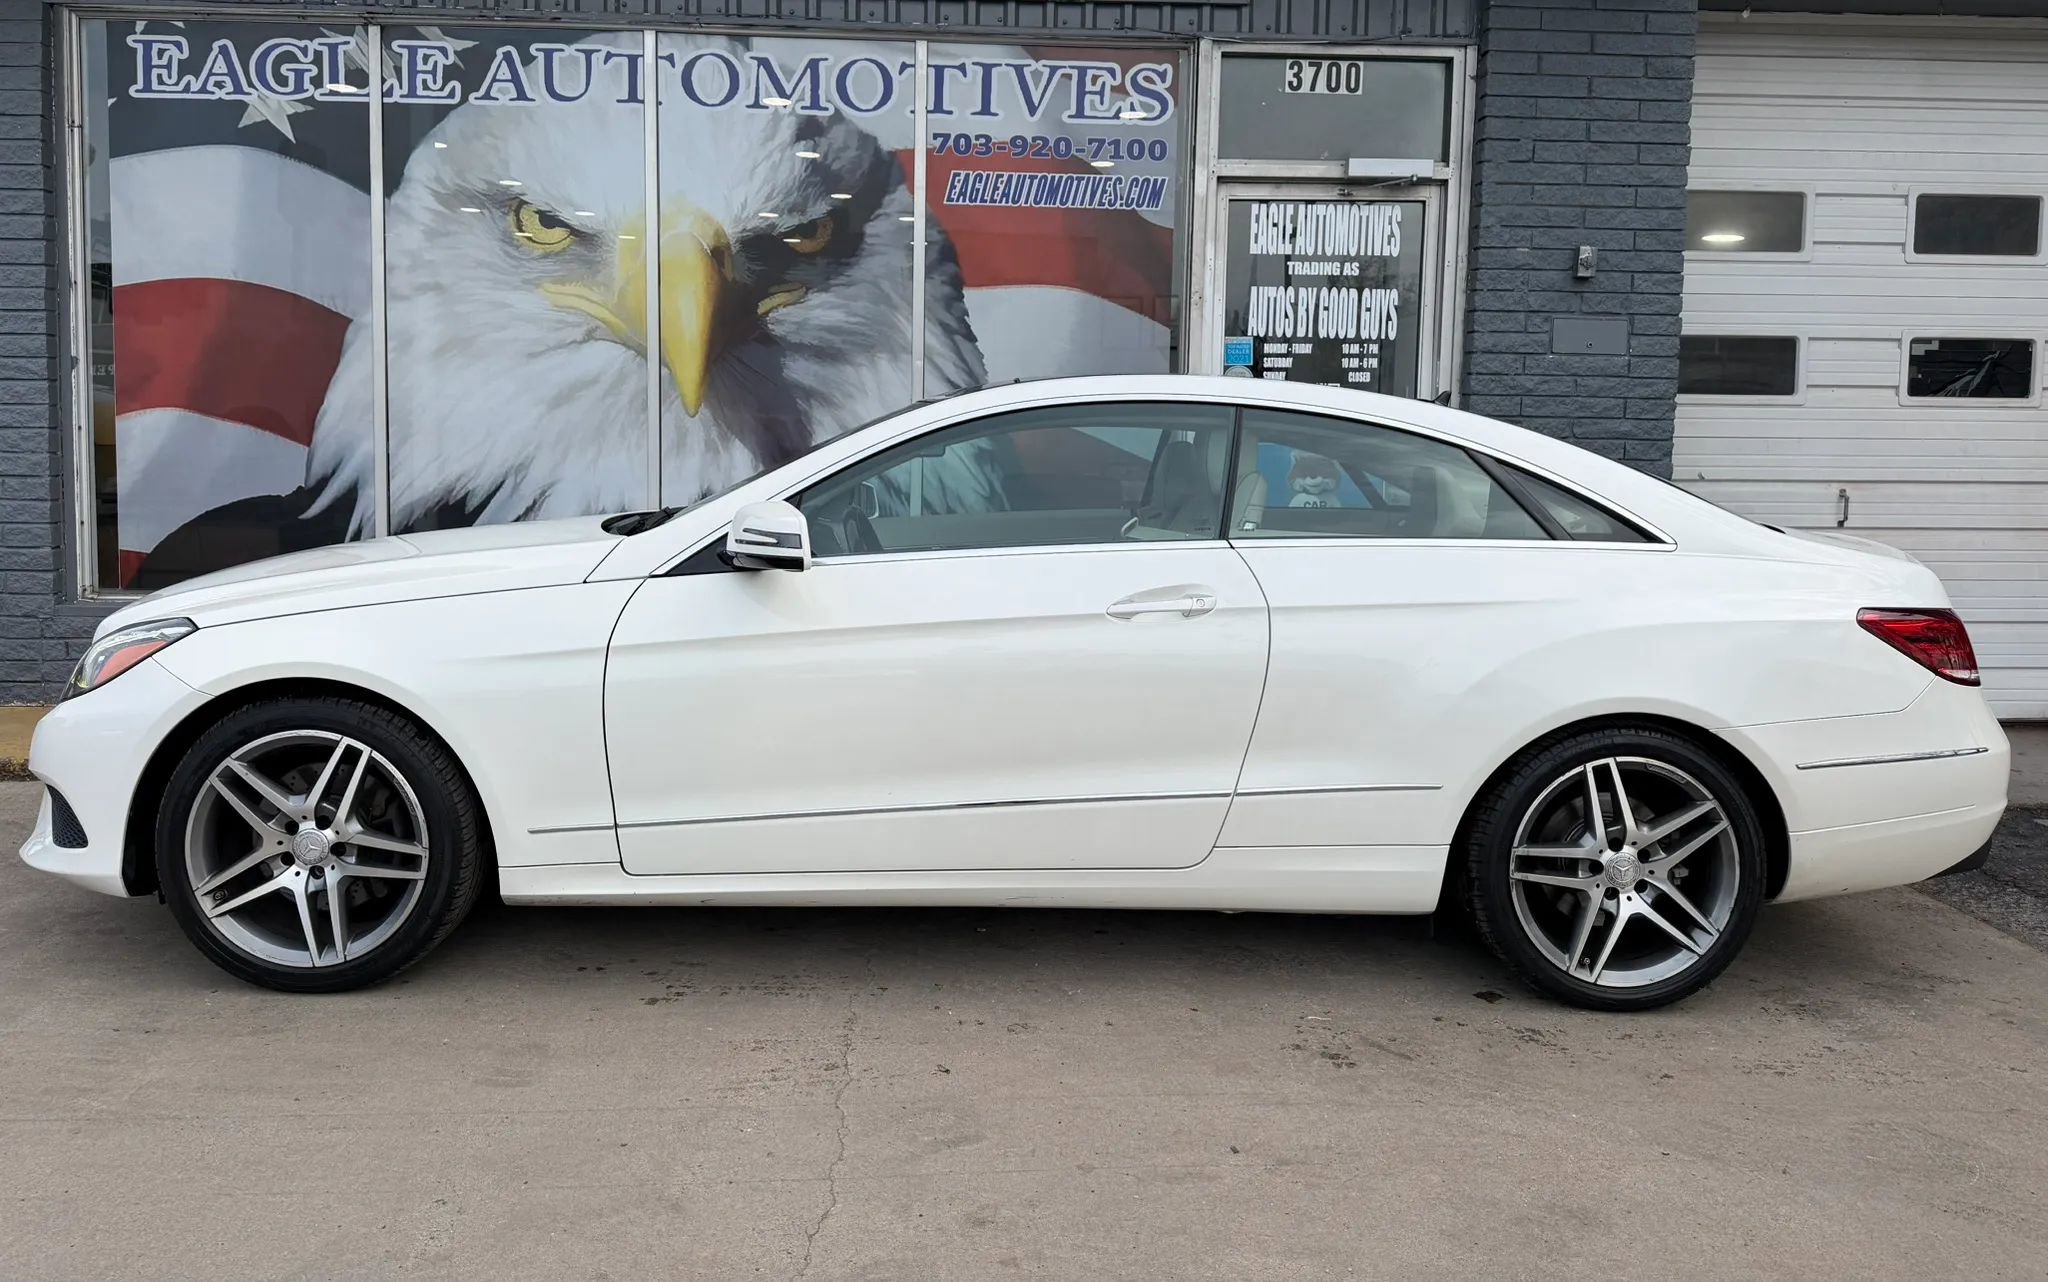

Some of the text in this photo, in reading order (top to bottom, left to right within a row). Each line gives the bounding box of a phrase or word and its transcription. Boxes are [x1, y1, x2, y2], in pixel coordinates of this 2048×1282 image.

[127, 34, 1175, 124] EAGLE AUTOMOTIVES
[1287, 60, 1361, 94] 3700
[931, 132, 1170, 163] 703-920-7100
[944, 169, 1168, 210] EAGLEAUTOMOTIVES.COM
[1249, 203, 1402, 257] EAGLE AUTOMOTIVES
[1287, 261, 1360, 276] TRADING AS
[1247, 286, 1399, 341] AUTOS BY GOOD GUYS
[1263, 343, 1288, 354] MONDAY
[1292, 343, 1313, 354] FRIDAY
[1342, 343, 1349, 354] 10
[1349, 343, 1360, 354] AM
[1363, 343, 1368, 354] 7
[1369, 343, 1379, 354] PM
[1263, 357, 1293, 368] SATURDAY
[1341, 357, 1349, 368] 10
[1349, 358, 1359, 368] AM
[1363, 358, 1368, 368] 6
[1368, 358, 1378, 368] PM
[1348, 371, 1371, 382] CLOSED
